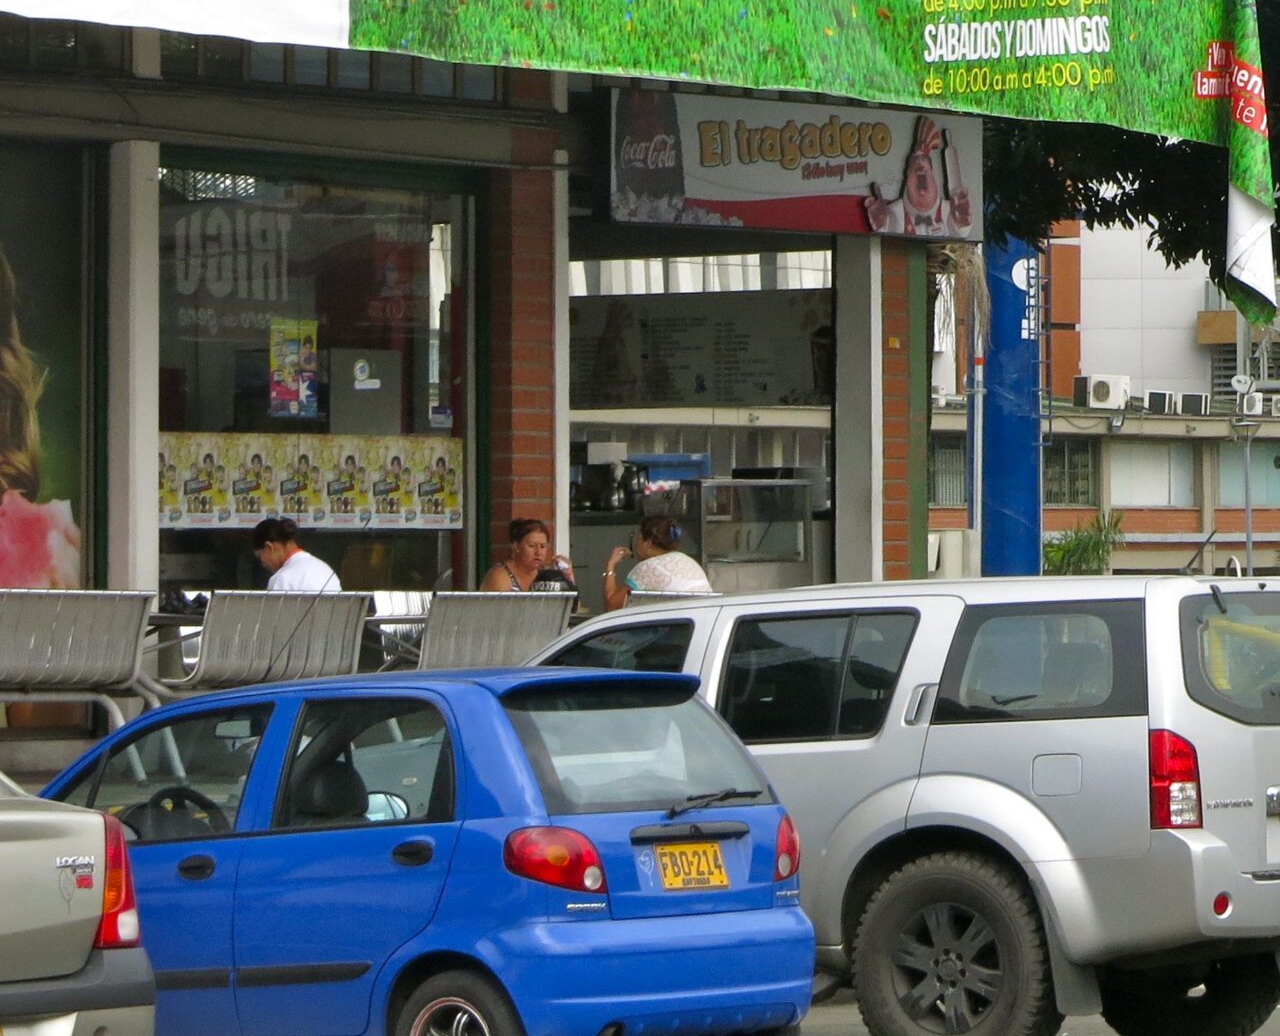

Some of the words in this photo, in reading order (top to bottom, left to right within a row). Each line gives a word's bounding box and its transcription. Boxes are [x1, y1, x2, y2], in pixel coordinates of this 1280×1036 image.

[923, 16, 1002, 63] SÁBADOS
[1003, 20, 1016, 58] Y
[1016, 15, 1111, 58] DOMINGOS
[923, 68, 943, 95] de
[948, 67, 990, 94] 10:00
[1022, 73, 1032, 88] a
[1035, 62, 1082, 87] 4:00
[697, 120, 730, 168] El
[736, 116, 892, 170] tragadero
[56, 855, 95, 867] LOGAN
